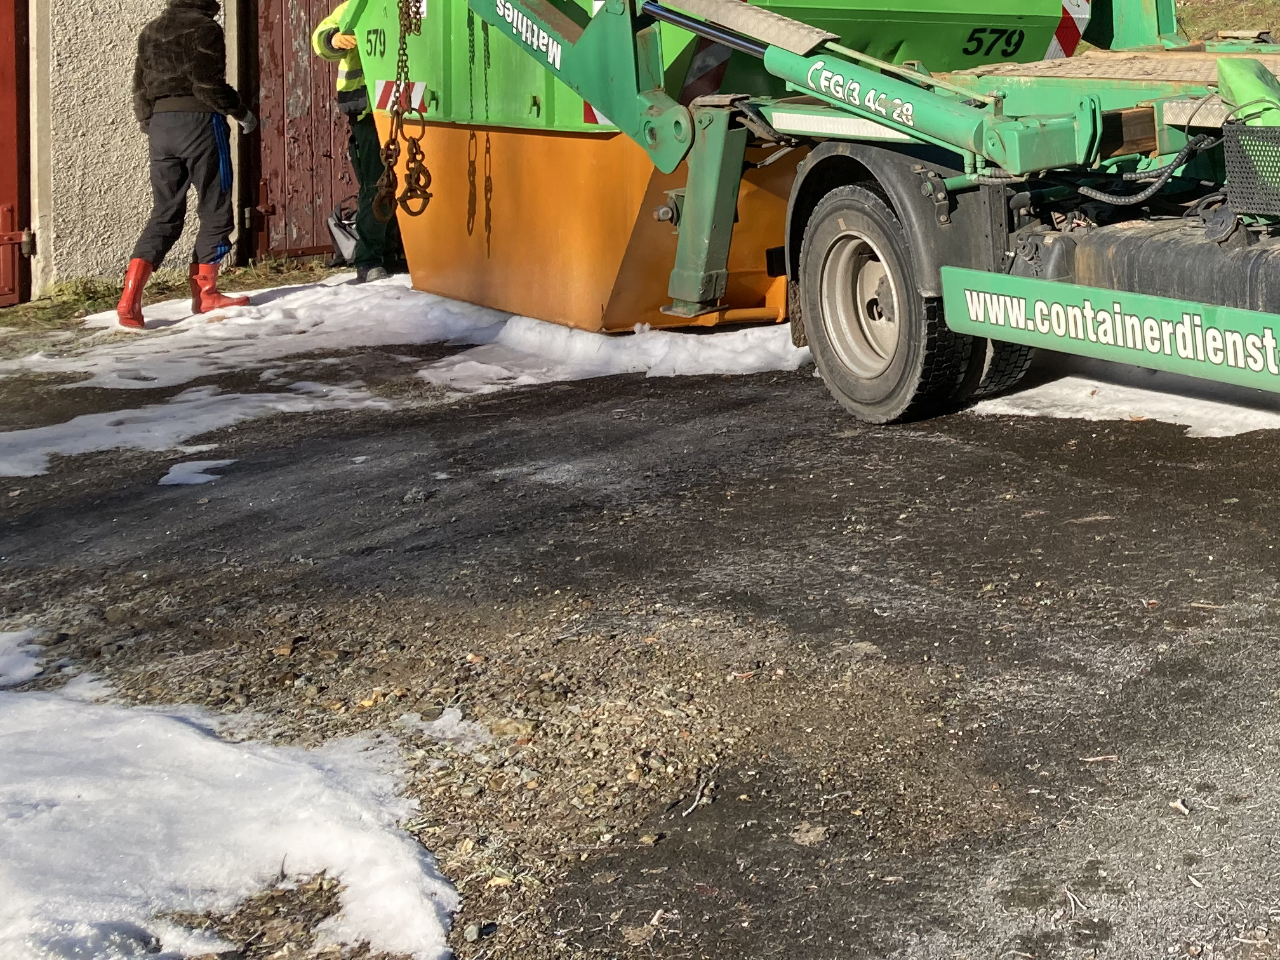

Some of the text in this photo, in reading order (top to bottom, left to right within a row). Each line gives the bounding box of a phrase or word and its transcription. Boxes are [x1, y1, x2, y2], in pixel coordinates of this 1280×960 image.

[366, 28, 386, 58] 579
[962, 28, 1025, 58] 579
[820, 69, 860, 106] FG/3
